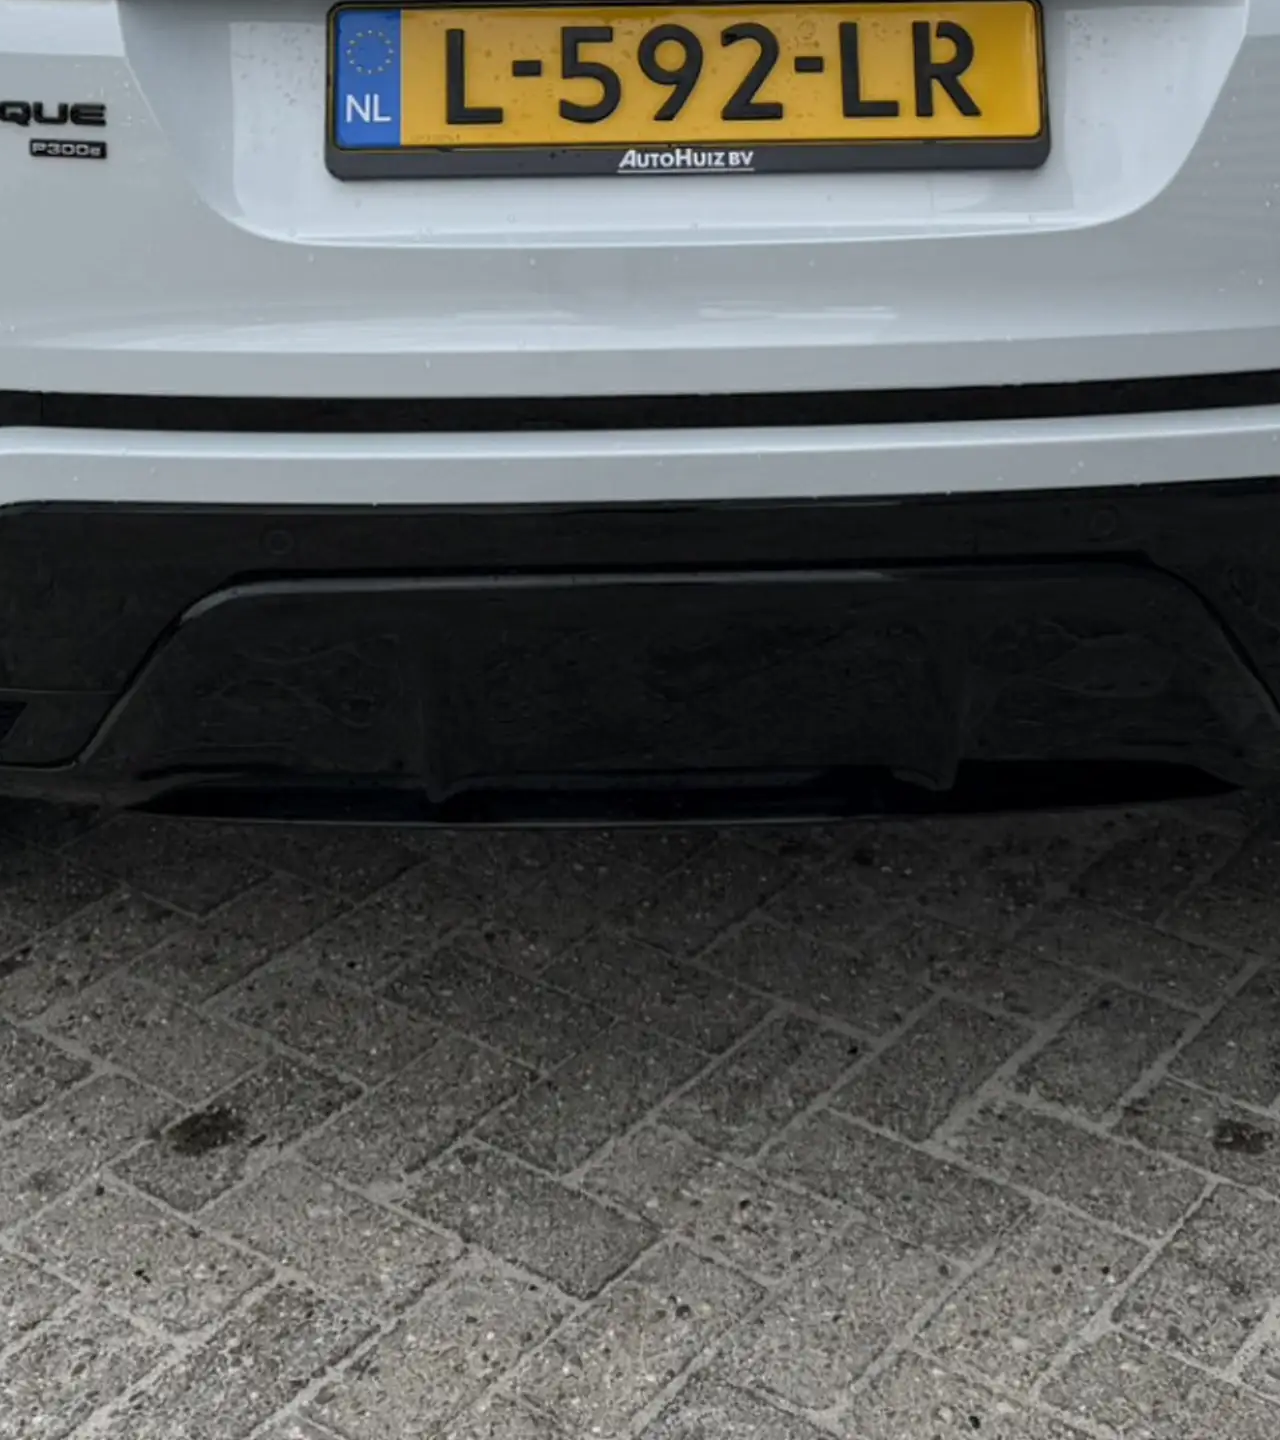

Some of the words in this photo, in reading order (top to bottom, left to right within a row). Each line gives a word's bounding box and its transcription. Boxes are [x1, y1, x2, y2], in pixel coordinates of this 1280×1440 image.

[445, 21, 981, 125] L-592-LR
[346, 95, 391, 124] NL
[728, 150, 754, 167] BV
